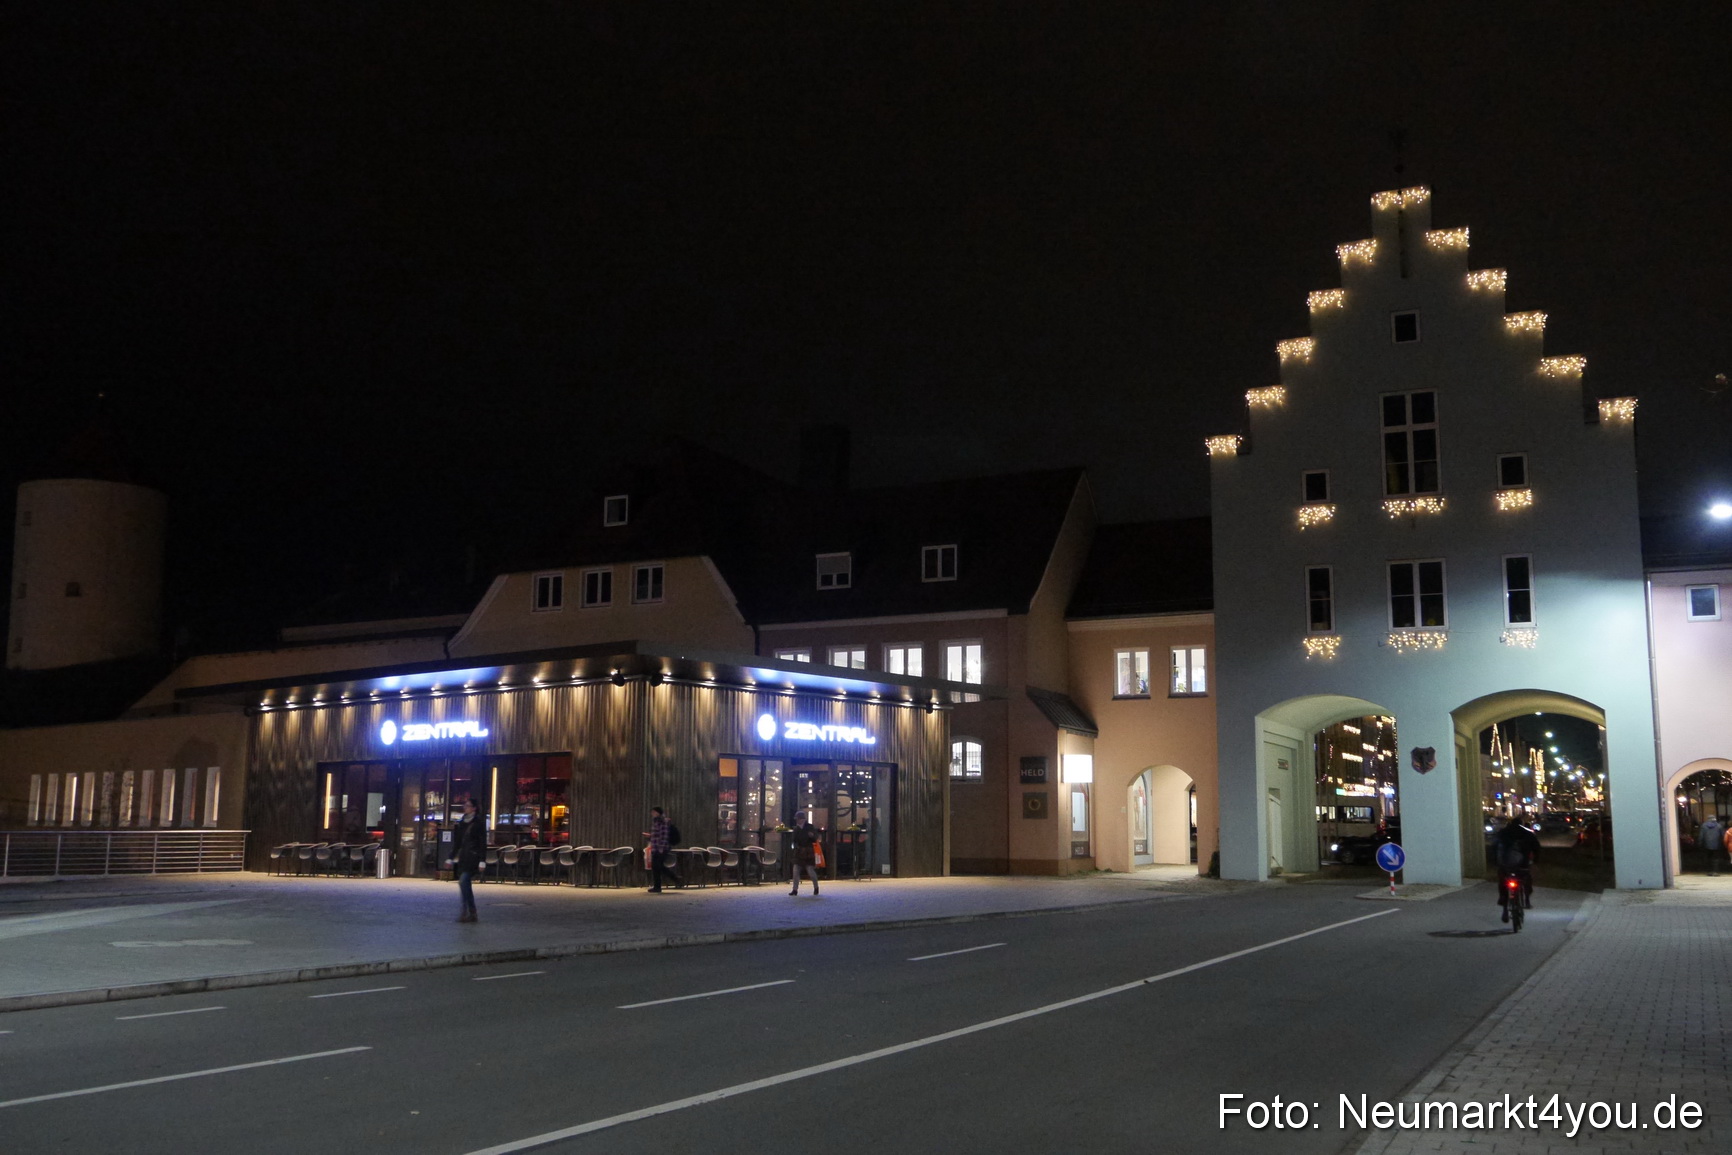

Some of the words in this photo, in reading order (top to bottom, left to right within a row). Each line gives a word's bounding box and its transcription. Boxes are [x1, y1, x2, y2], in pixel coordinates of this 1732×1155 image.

[402, 721, 489, 741] ZENTRAL
[784, 721, 876, 744] ZENTRAL
[1020, 768, 1045, 777] HELD
